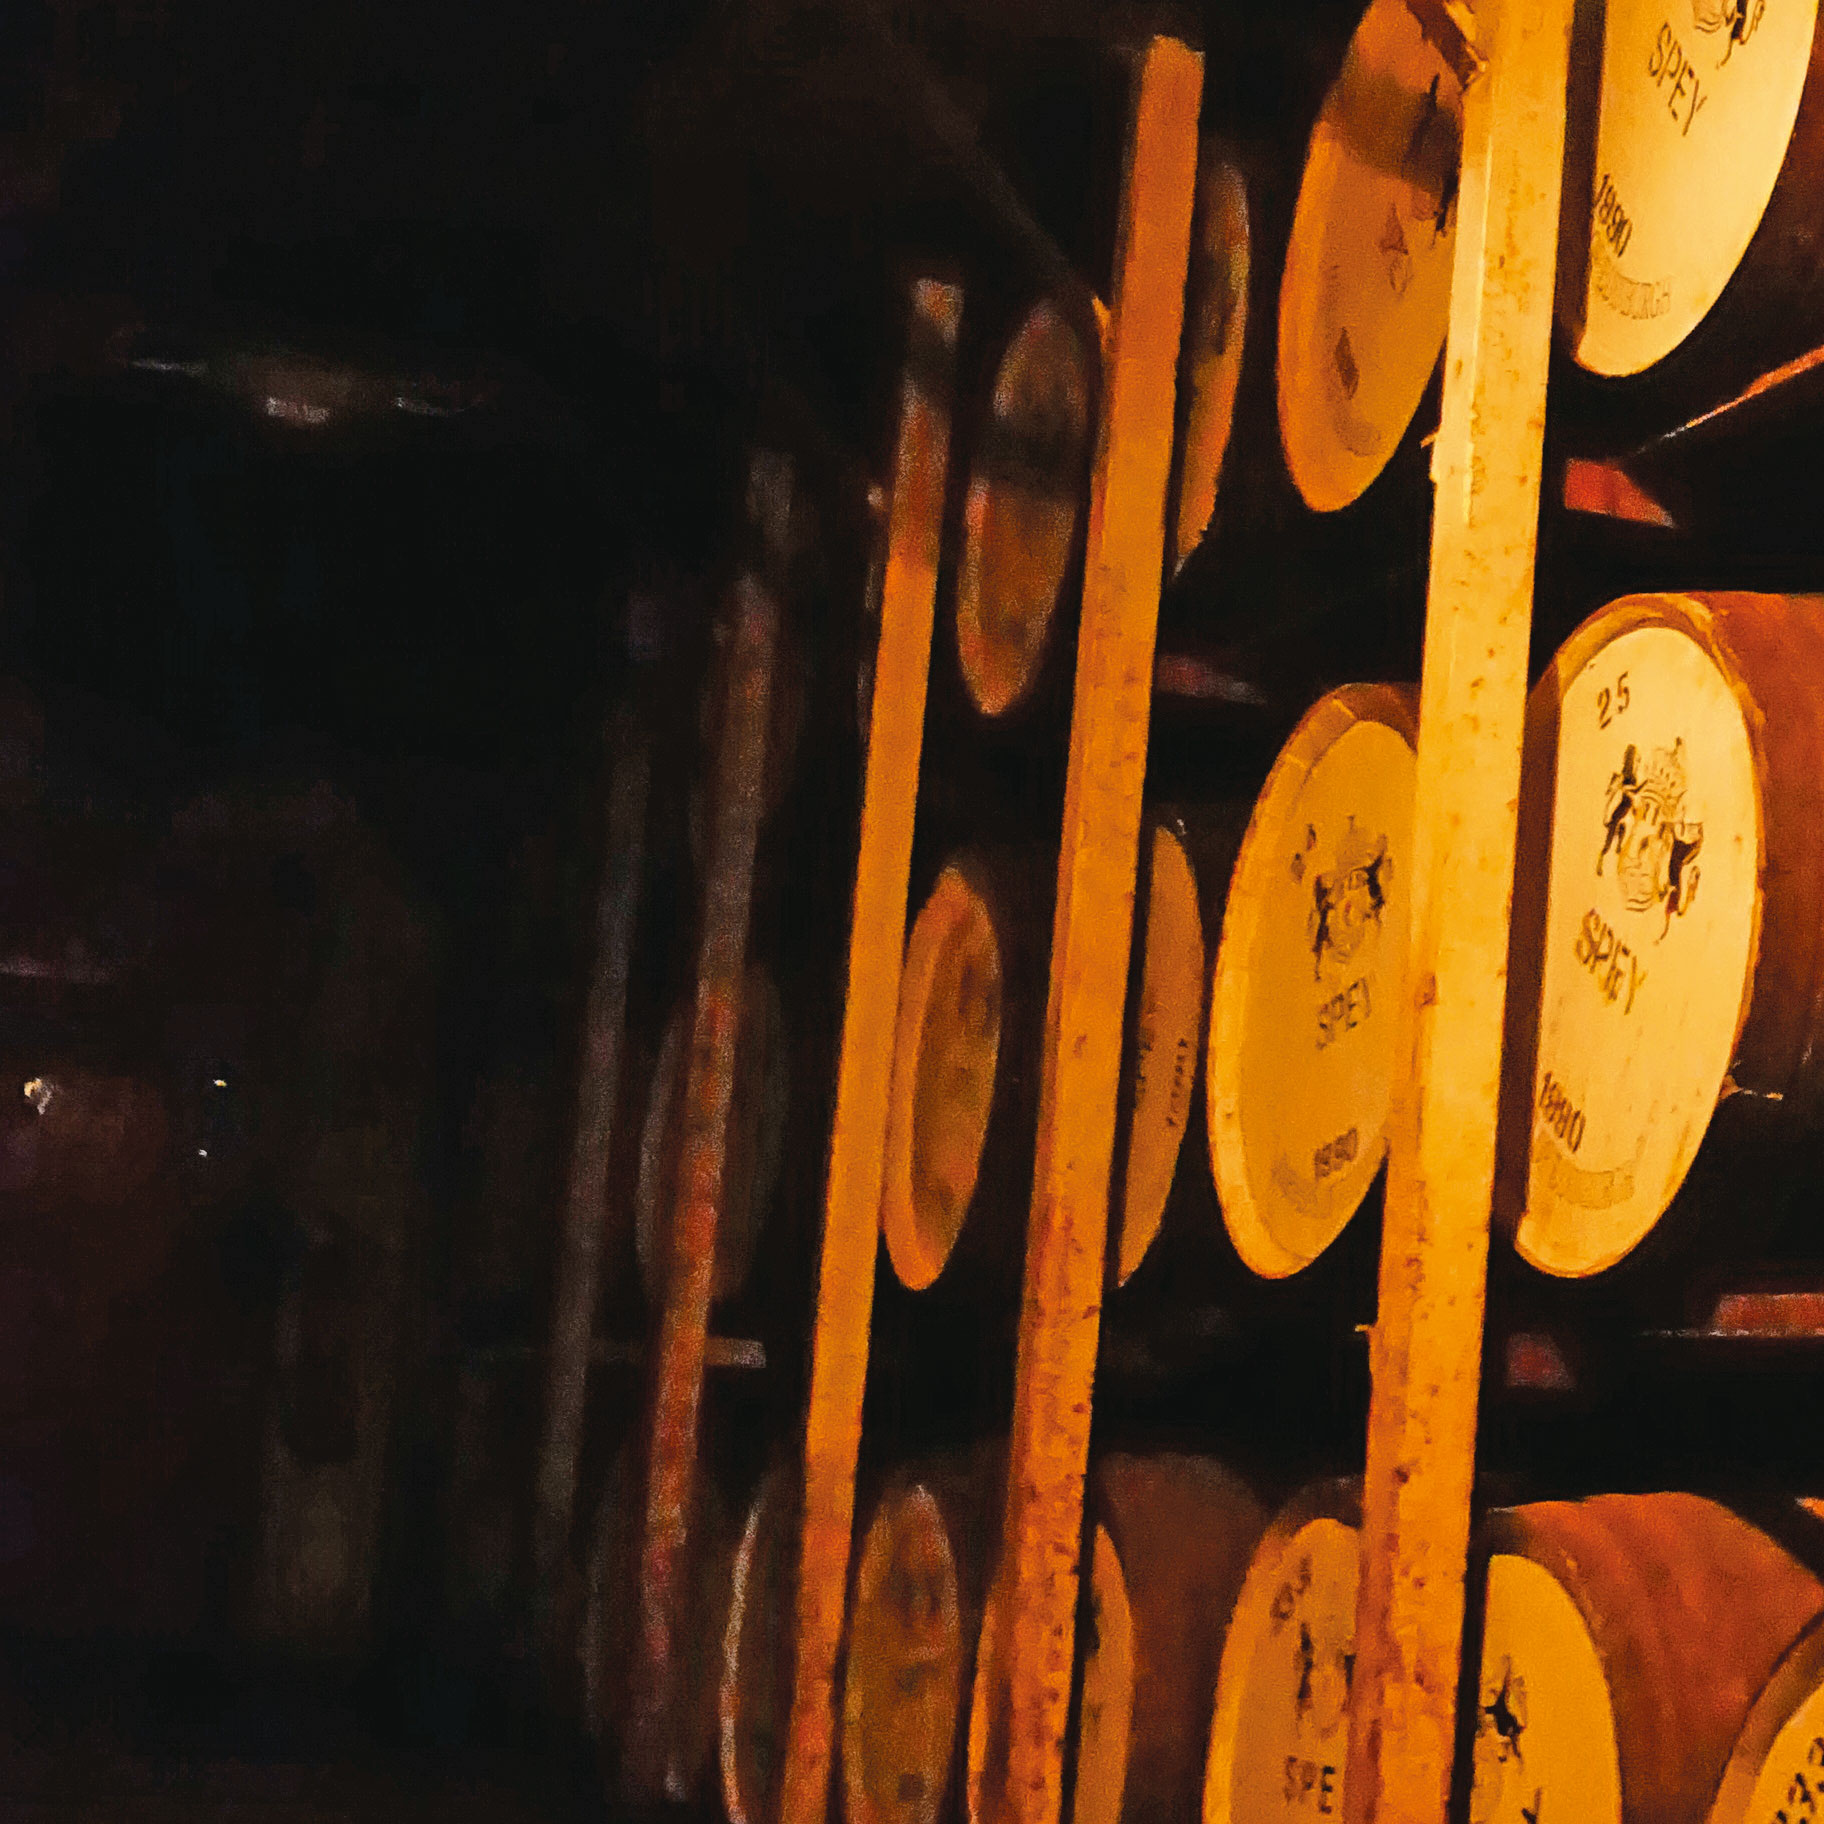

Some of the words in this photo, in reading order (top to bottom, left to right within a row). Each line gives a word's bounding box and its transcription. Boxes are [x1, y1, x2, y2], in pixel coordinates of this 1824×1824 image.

[1648, 22, 1708, 137] SPEY
[1597, 671, 1631, 731] 25
[1574, 906, 1648, 1017] SPEY
[1285, 1754, 1337, 1815] SPE
